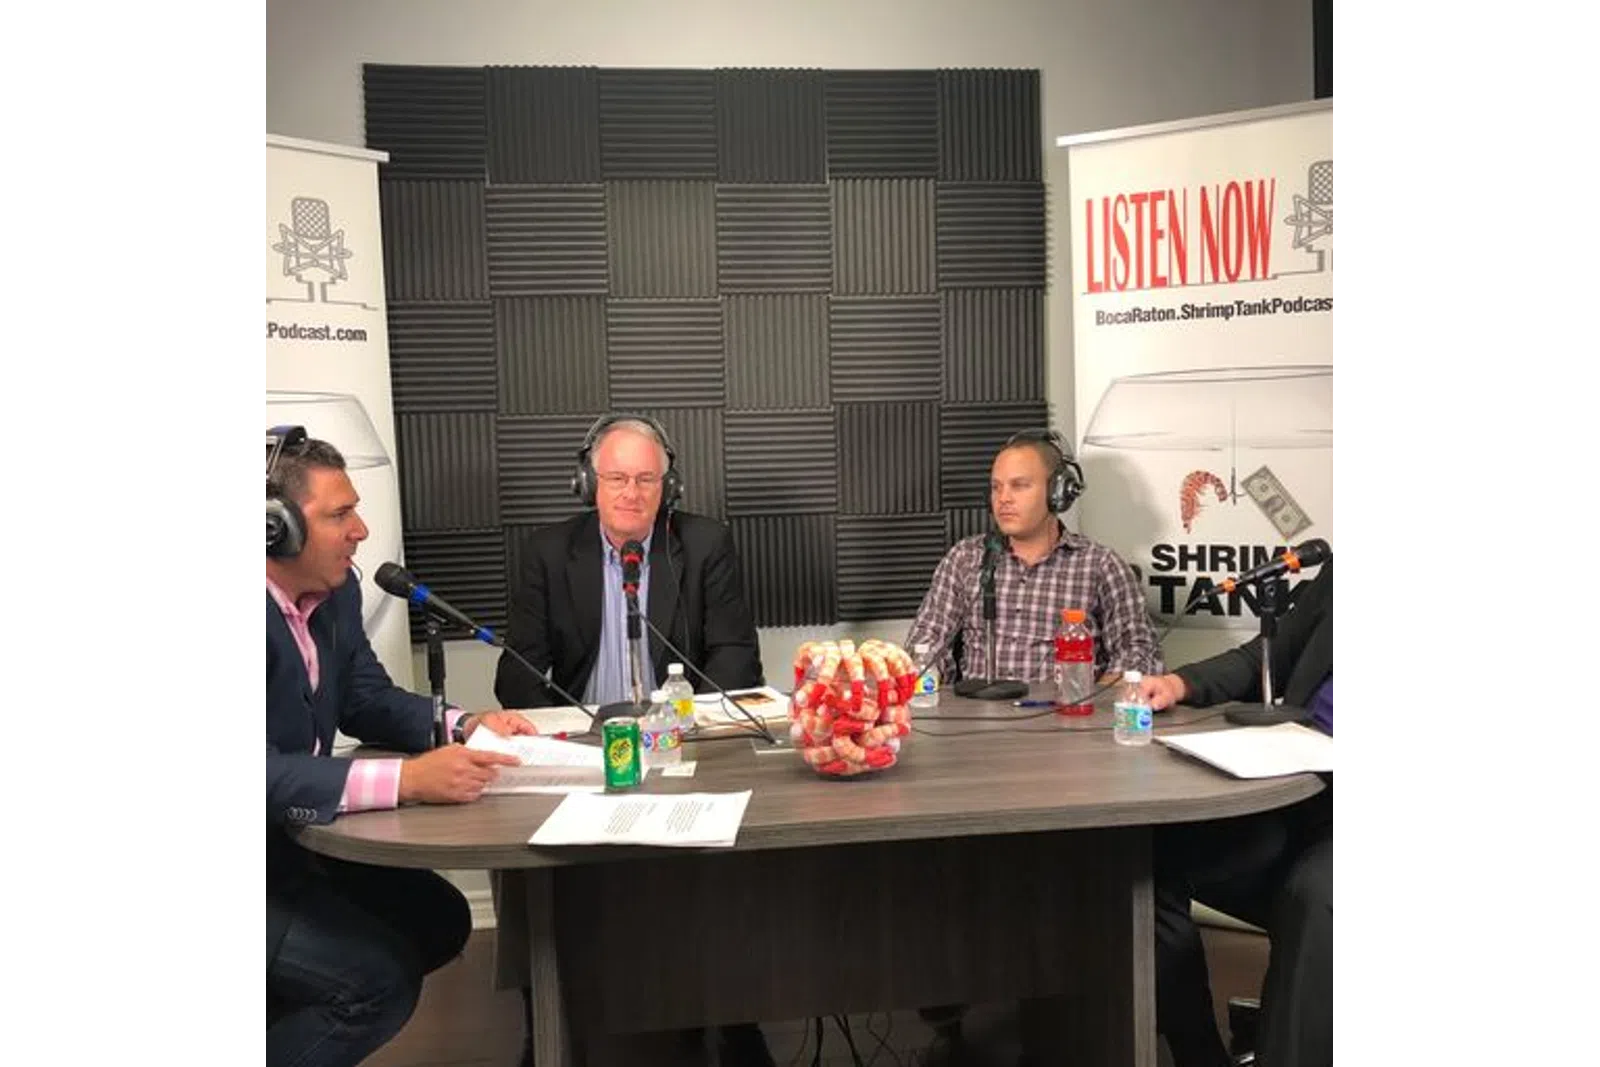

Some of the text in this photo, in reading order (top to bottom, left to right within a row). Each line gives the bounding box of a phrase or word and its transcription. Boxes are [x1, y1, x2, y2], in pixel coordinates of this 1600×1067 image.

[1085, 178, 1276, 294] LISTEN NOW
[1095, 296, 1336, 326] BocaRaton.ShrimpTankPodcas
[265, 322, 368, 342] Podcast.com
[1151, 543, 1300, 573] SHRIM
